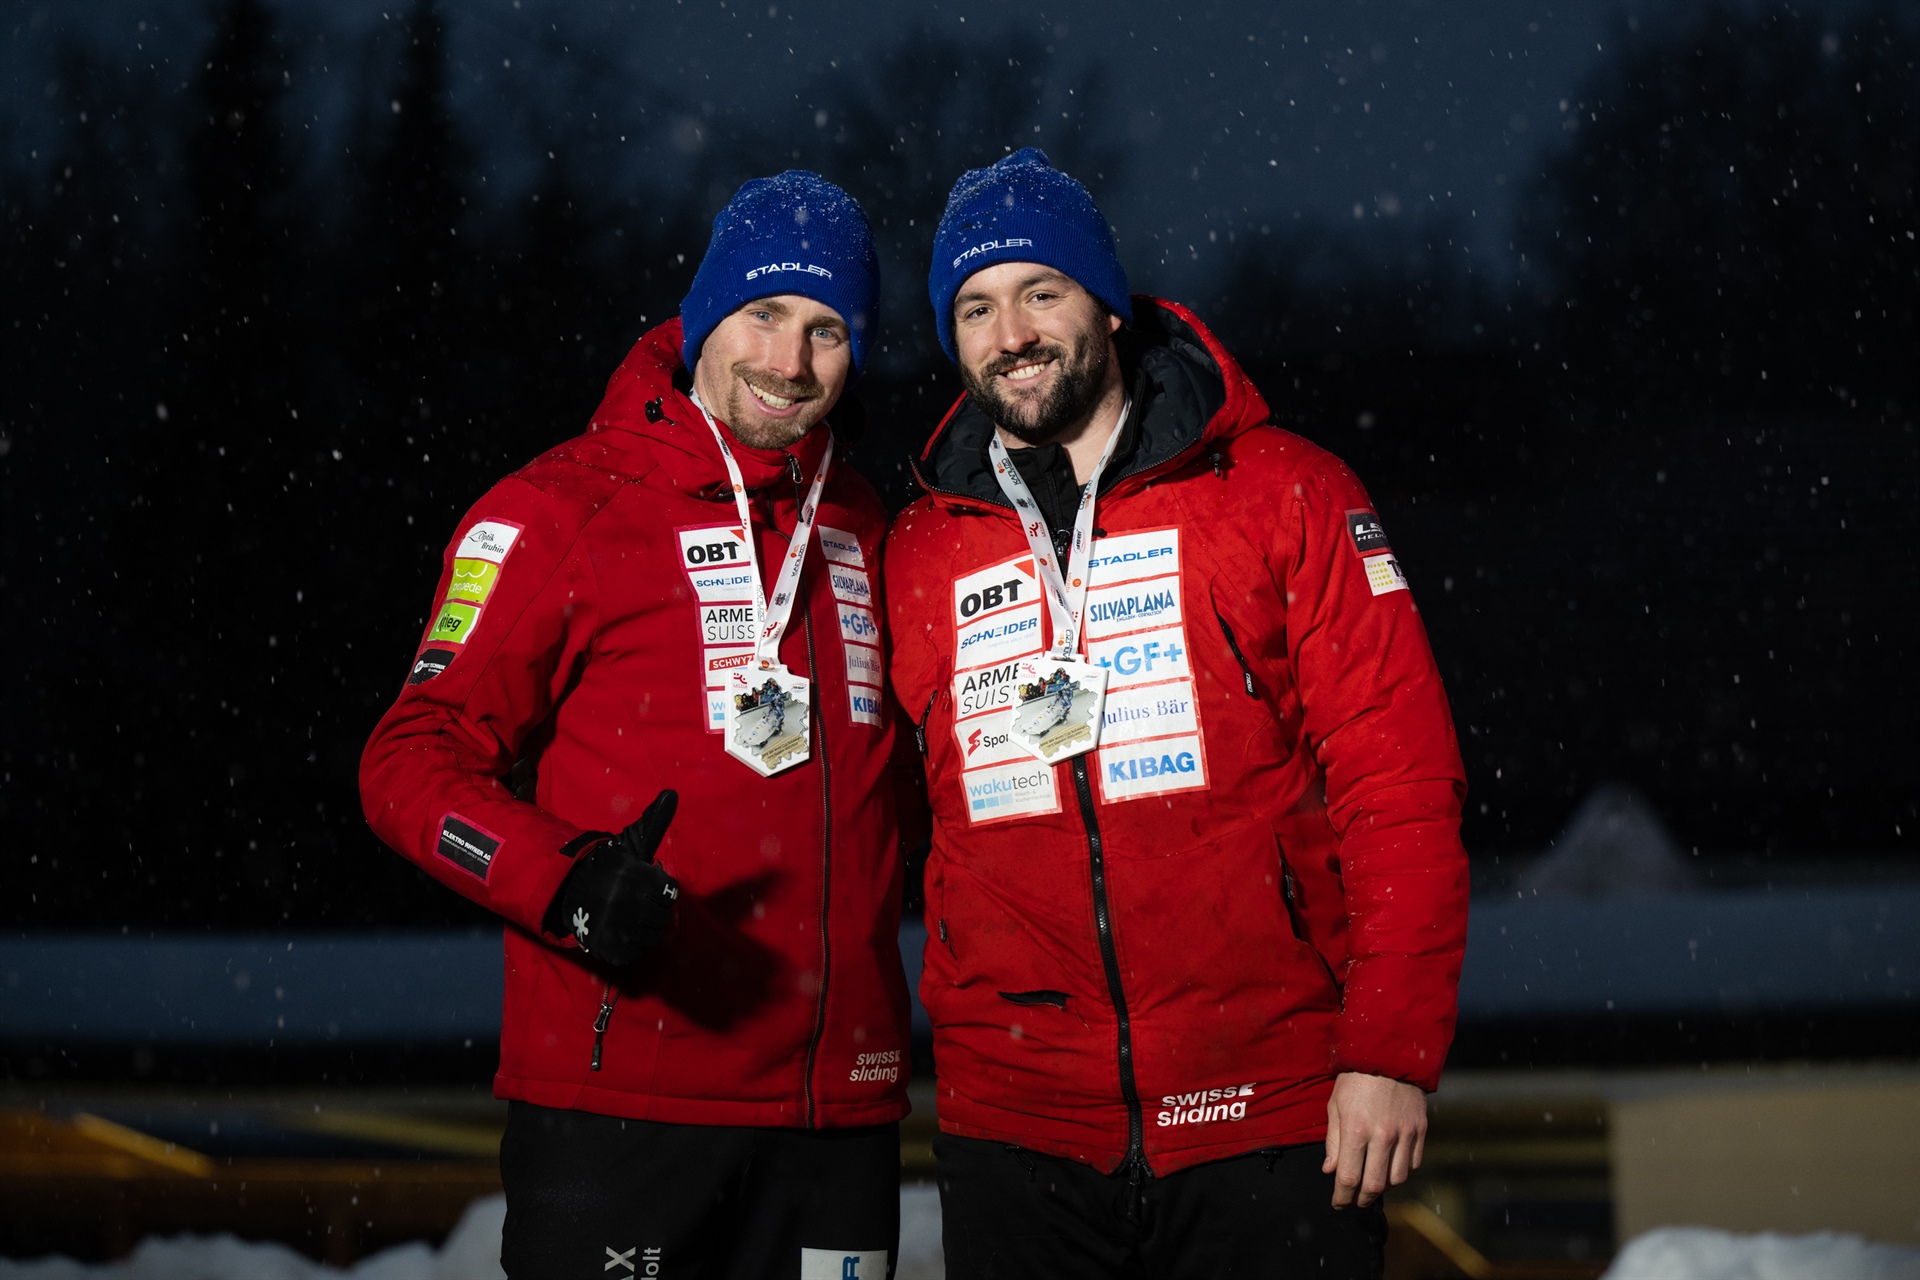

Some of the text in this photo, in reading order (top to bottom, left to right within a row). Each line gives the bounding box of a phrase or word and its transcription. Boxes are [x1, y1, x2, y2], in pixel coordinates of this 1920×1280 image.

[953, 238, 1033, 268] STADLER
[746, 262, 832, 280] STADLER
[478, 533, 495, 542] Optik
[481, 542, 504, 554] Bruhin
[823, 540, 861, 554] STADLER
[687, 541, 740, 564] OBT
[1088, 547, 1173, 568] STADLER
[696, 575, 752, 588] SCHNEIDE
[832, 574, 869, 595] SILVAPLANA
[960, 578, 1023, 617] OBT
[1090, 589, 1175, 622] SILVAPLANA
[705, 608, 754, 624] ARME
[707, 624, 755, 641] SUISS
[961, 617, 1038, 649] SCHNEIDER
[848, 655, 870, 669] Julius
[962, 662, 1019, 695] ARME
[962, 685, 1009, 714] SUIS
[1102, 699, 1189, 729] Julius Bär
[1108, 752, 1195, 783] KIBAG
[969, 771, 1049, 798] wakutech
[442, 829, 465, 846] ELEKTRO
[856, 1051, 895, 1065] swiss
[849, 1065, 898, 1083] sliding
[1162, 1086, 1238, 1107] swiss
[1157, 1101, 1246, 1127] sliding
